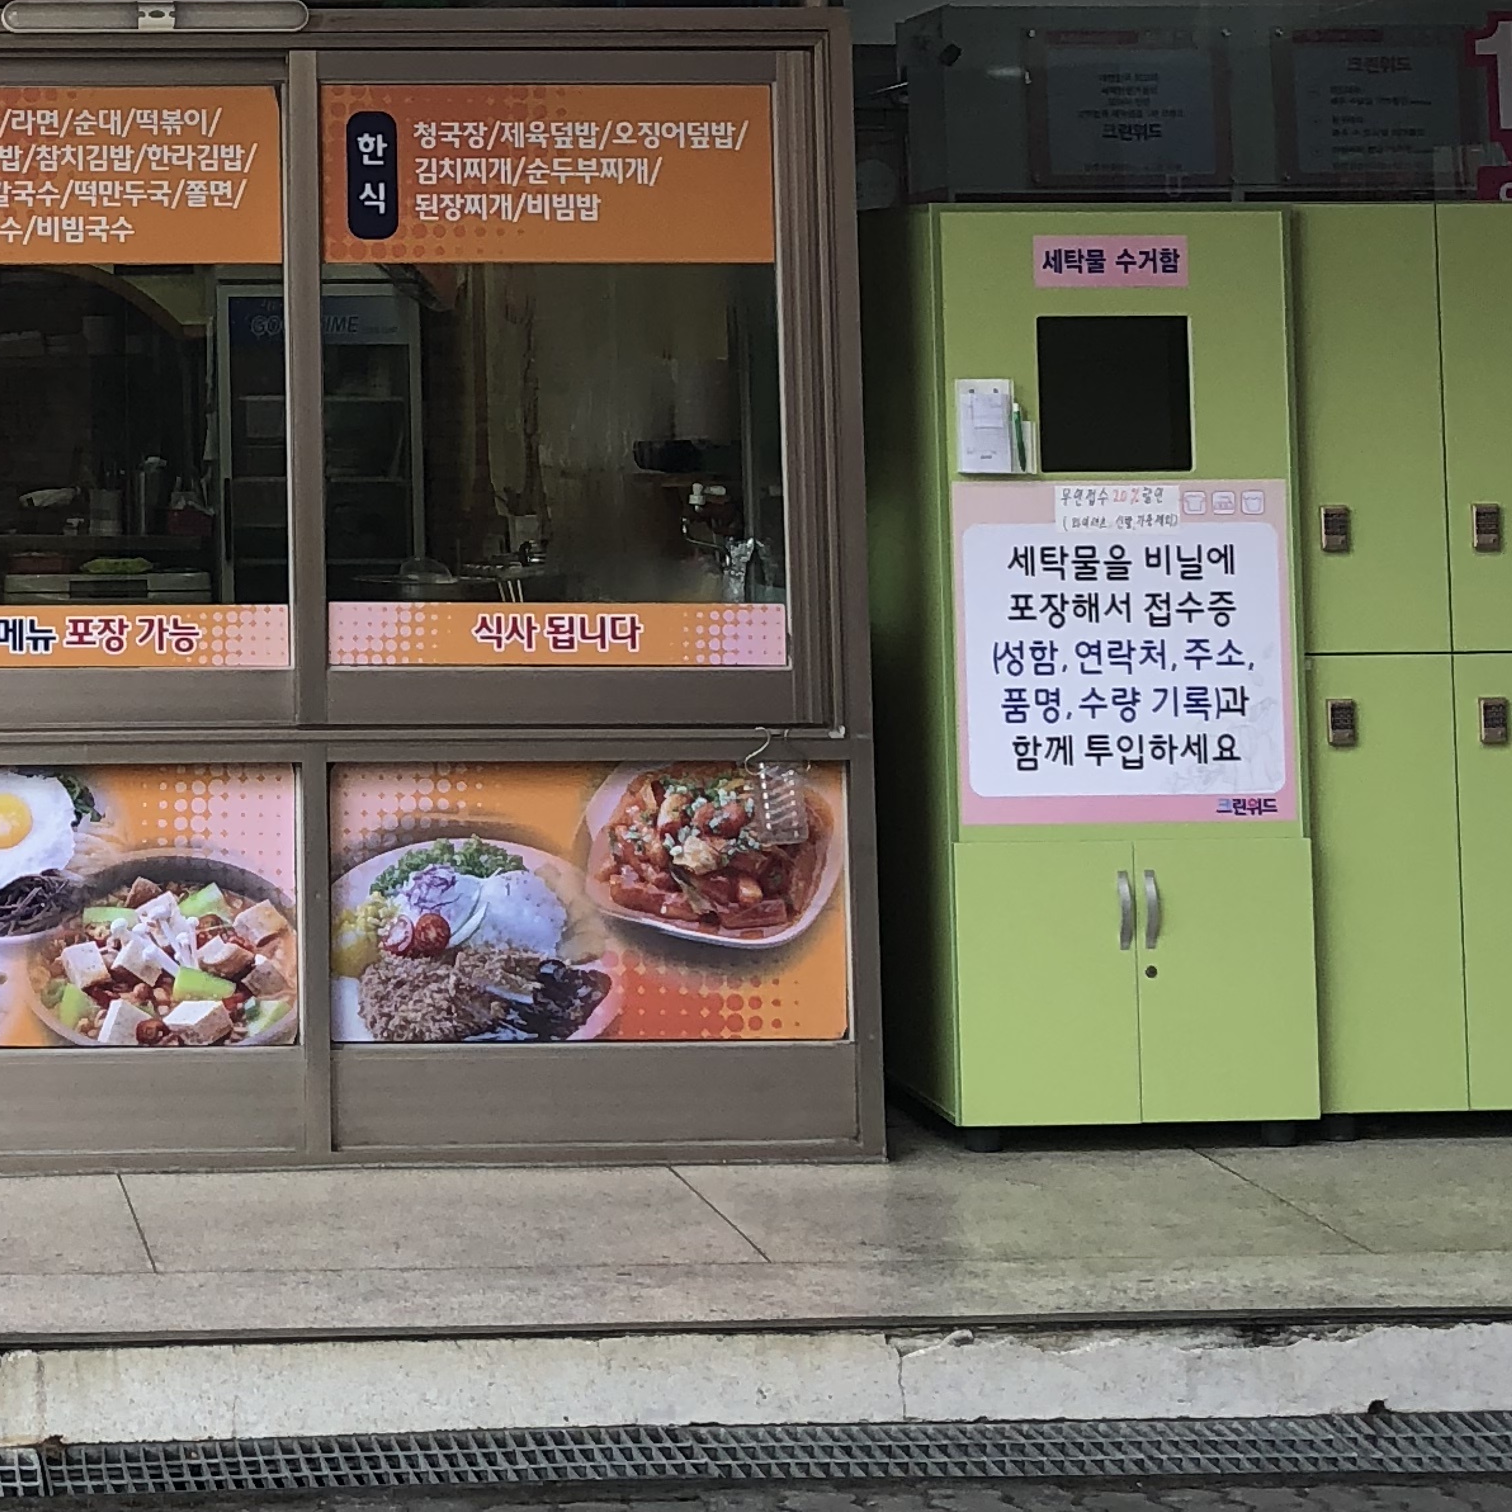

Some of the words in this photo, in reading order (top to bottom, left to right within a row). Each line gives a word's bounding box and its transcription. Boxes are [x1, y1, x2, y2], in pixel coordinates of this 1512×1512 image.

[356, 133, 388, 215] 한식
[1041, 248, 1107, 275] 세탁물
[1114, 247, 1180, 274] 수거함
[1007, 544, 1133, 581] 세탁물을
[1144, 544, 1236, 580] 비닐에
[1007, 592, 1133, 628] 포장해서
[1143, 591, 1238, 628] 접수증
[65, 617, 130, 653] 포장
[137, 617, 200, 653] 가능
[474, 615, 537, 651] 식사
[545, 615, 642, 651] 됩니다
[1074, 640, 1178, 675] 연락처,
[1183, 639, 1256, 672] 주소,
[1151, 686, 1250, 721] 기록)과
[1012, 734, 1074, 771] 함께
[1084, 733, 1242, 769] 투입하세요
[1216, 798, 1279, 816] 크린위드
